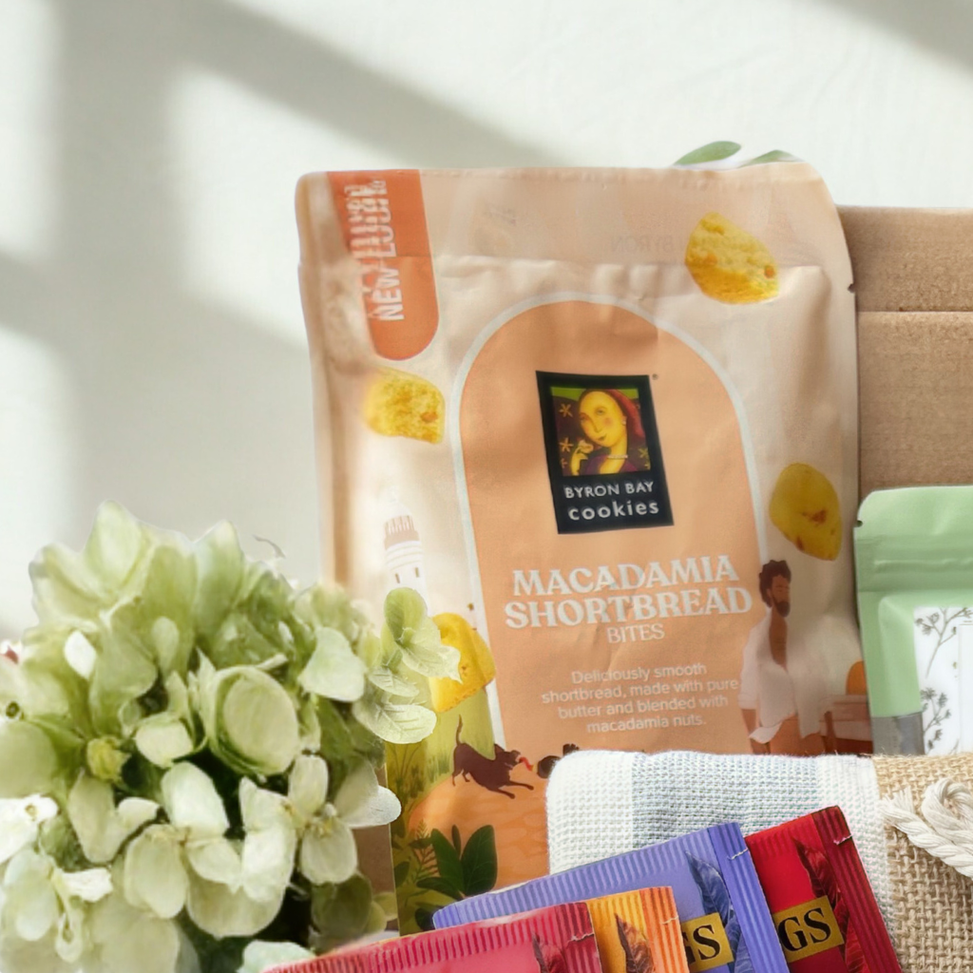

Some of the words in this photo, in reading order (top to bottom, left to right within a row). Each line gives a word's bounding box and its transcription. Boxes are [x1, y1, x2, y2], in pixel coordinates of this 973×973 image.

[564, 483, 620, 499] BYRON
[625, 481, 654, 494] BAY
[568, 500, 660, 521] cookies
[512, 554, 740, 597] MACADAMIA
[504, 587, 753, 629] SHORTBREAD
[606, 623, 666, 644] BITES
[571, 666, 650, 685] Deliciously
[653, 662, 707, 678] smooth
[541, 685, 627, 704] shortbread,
[629, 682, 671, 697] made
[673, 679, 703, 693] with
[706, 678, 739, 693] pure
[558, 704, 601, 720] butter
[605, 702, 634, 716] and
[636, 697, 696, 713] blended
[699, 694, 729, 708] with
[586, 716, 669, 734] macadamia
[672, 714, 707, 728] nuts.
